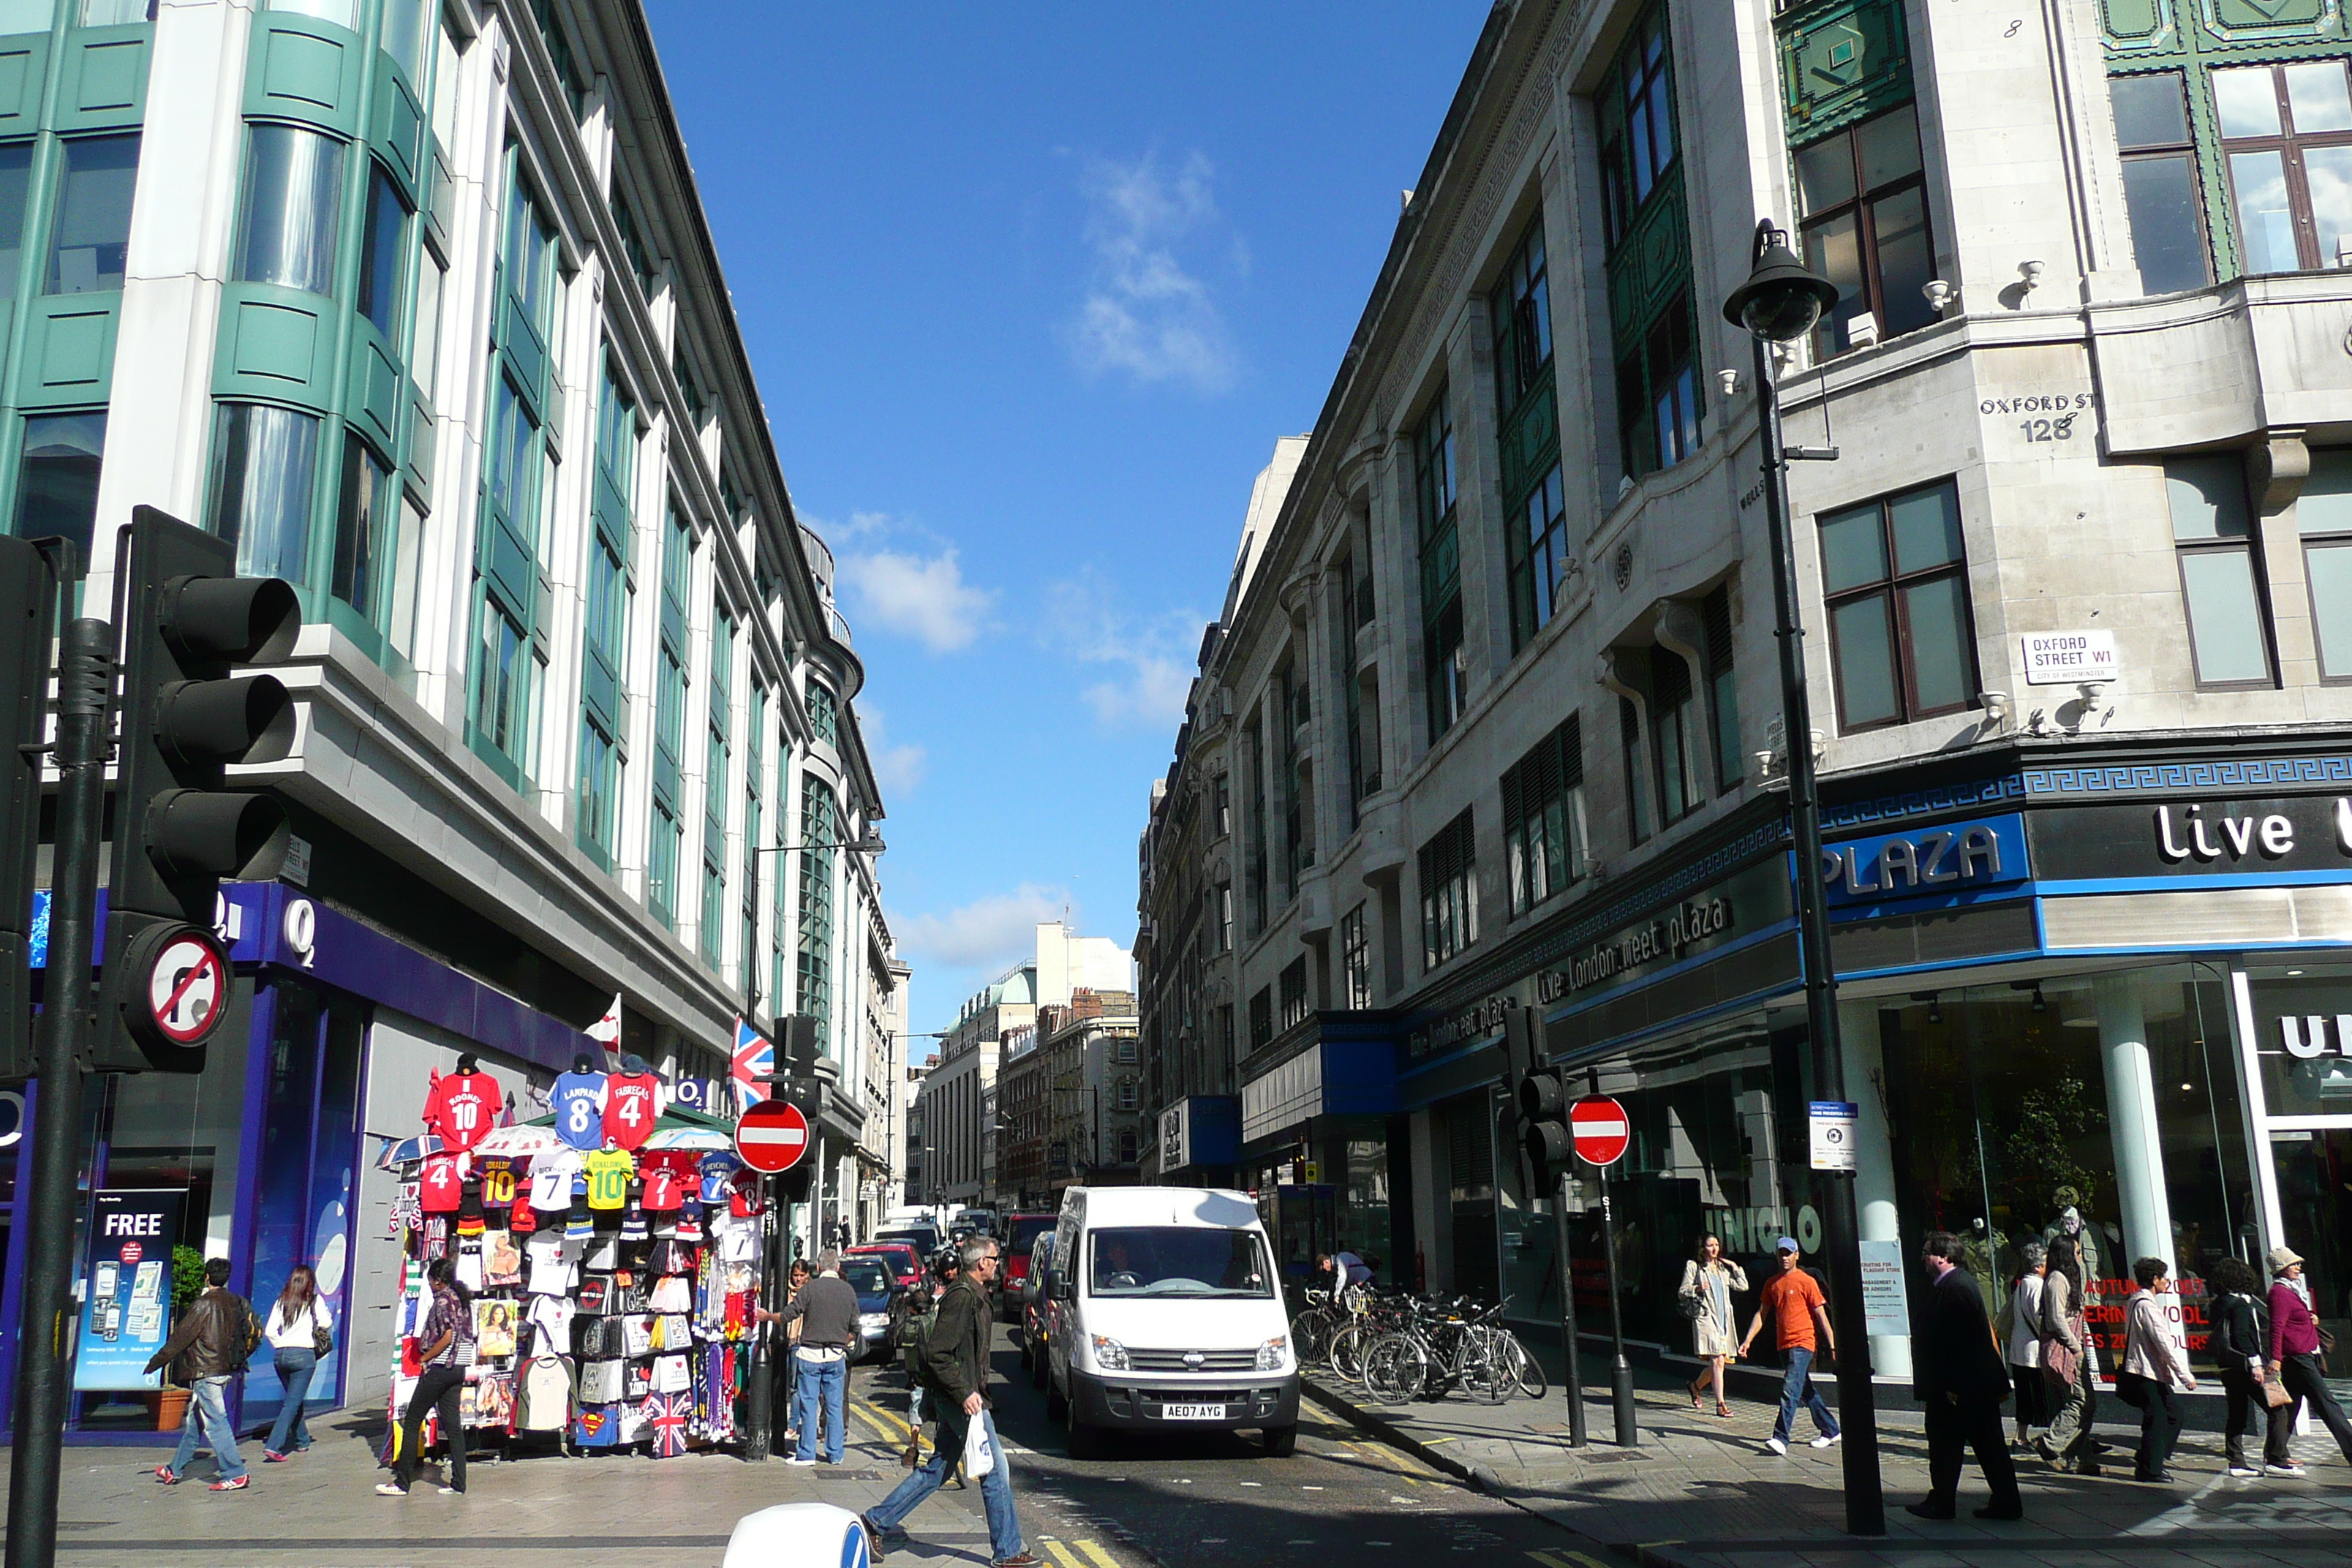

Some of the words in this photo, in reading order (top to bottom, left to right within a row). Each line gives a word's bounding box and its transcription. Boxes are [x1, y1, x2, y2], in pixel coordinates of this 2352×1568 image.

[1980, 396, 2069, 415] OXFORD
[2019, 418, 2073, 443] 128
[2033, 637, 2087, 652] OXFORD
[2035, 652, 2084, 666] STREET
[2092, 650, 2111, 663] W1
[2062, 670, 2106, 678] WESTMINSTER
[2158, 804, 2294, 858] live
[284, 900, 315, 969] O2
[1669, 898, 1724, 960] plaza
[448, 1093, 483, 1106] ROONEY
[564, 1088, 599, 1100] LAMPARD
[614, 1085, 649, 1101] FABREGAS
[677, 1081, 703, 1107] O2
[451, 1103, 477, 1131] 10
[569, 1098, 589, 1133] 8
[619, 1096, 641, 1128] 4
[429, 1158, 455, 1169] FABREGAS
[429, 1166, 448, 1188] 4
[485, 1171, 515, 1202] 10
[545, 1175, 561, 1199] 7
[594, 1169, 622, 1200] 10
[657, 1172, 671, 1194] 7
[710, 1171, 727, 1198] 7
[2084, 1278, 2141, 1295] AUTUM
[2165, 1278, 2204, 1295] 2007
[1168, 1406, 1196, 1417] AE07
[1199, 1406, 1221, 1417] AYG
